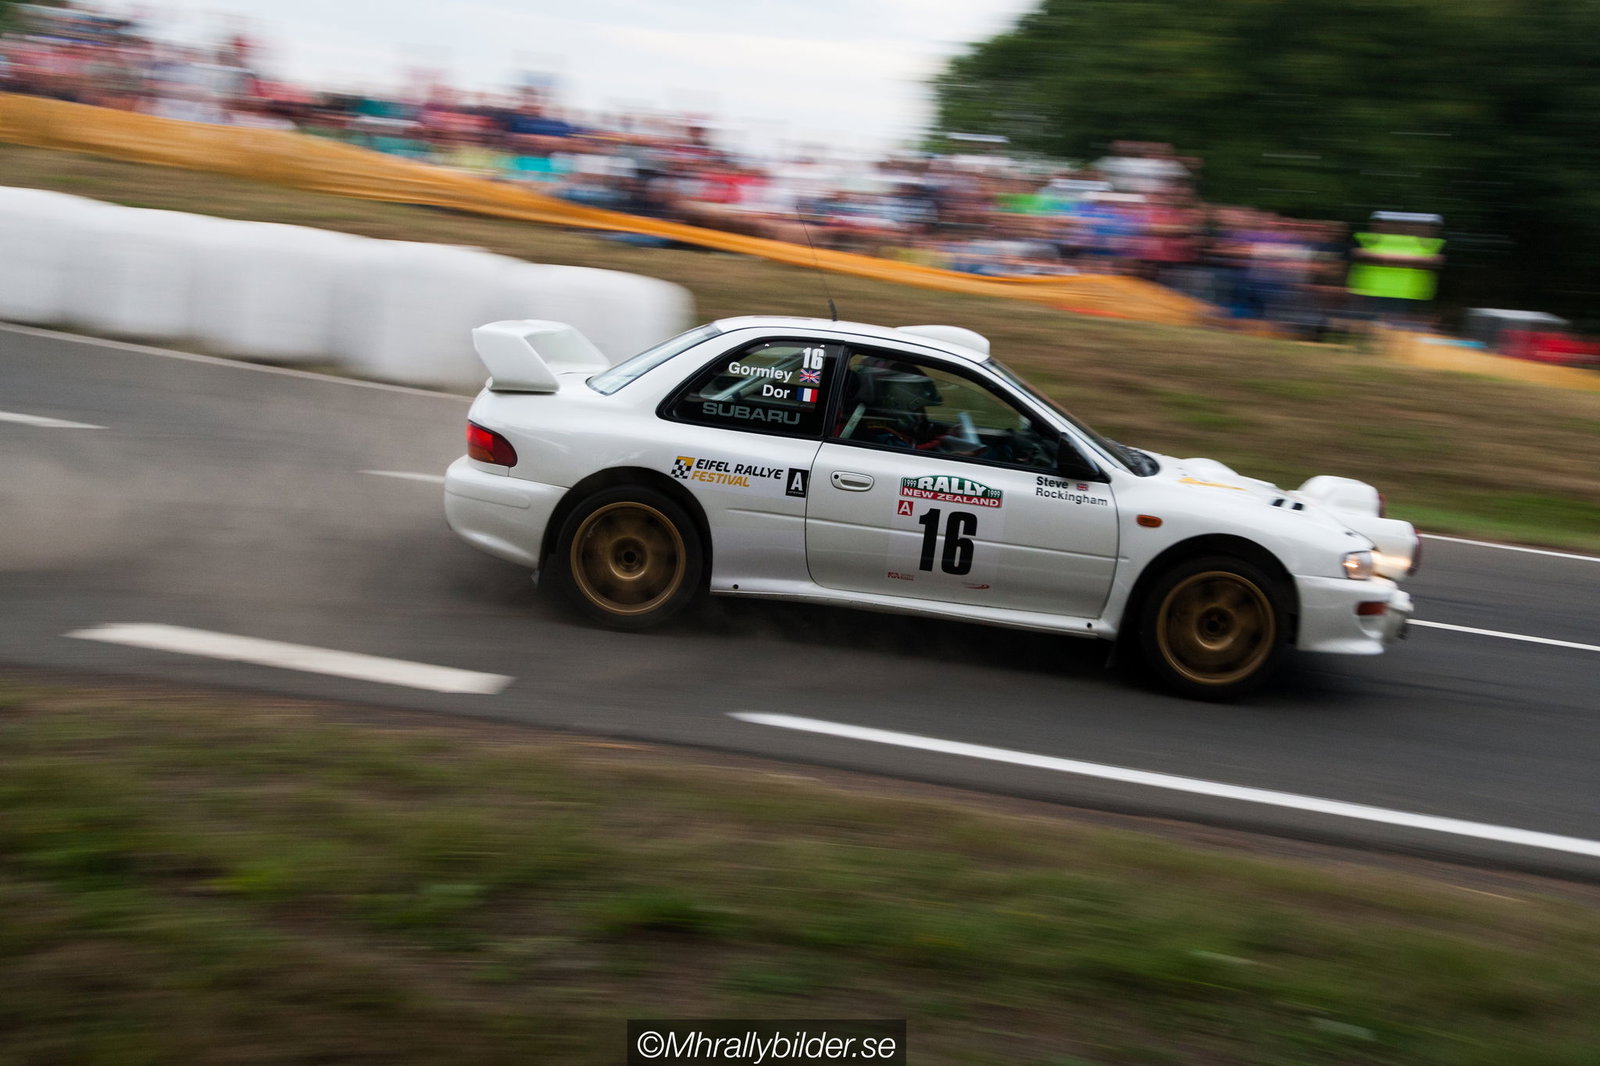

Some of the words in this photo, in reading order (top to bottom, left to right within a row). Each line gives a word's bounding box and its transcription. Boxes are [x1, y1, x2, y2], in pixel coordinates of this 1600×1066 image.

[803, 347, 824, 370] 16
[728, 362, 792, 382] Gormley
[762, 384, 790, 398] Dor
[702, 402, 800, 424] SUBARU
[691, 470, 750, 488] FESTIVAL
[696, 458, 730, 472] EIFEL
[734, 464, 784, 480] RALLYE
[790, 472, 803, 492] A
[918, 476, 986, 496] RALLY
[1036, 476, 1068, 489] Steve
[904, 488, 934, 498] NEW
[937, 492, 999, 506] ZEALAND
[1036, 487, 1108, 506] Rockingham
[899, 502, 912, 515] A
[919, 508, 978, 576] 16
